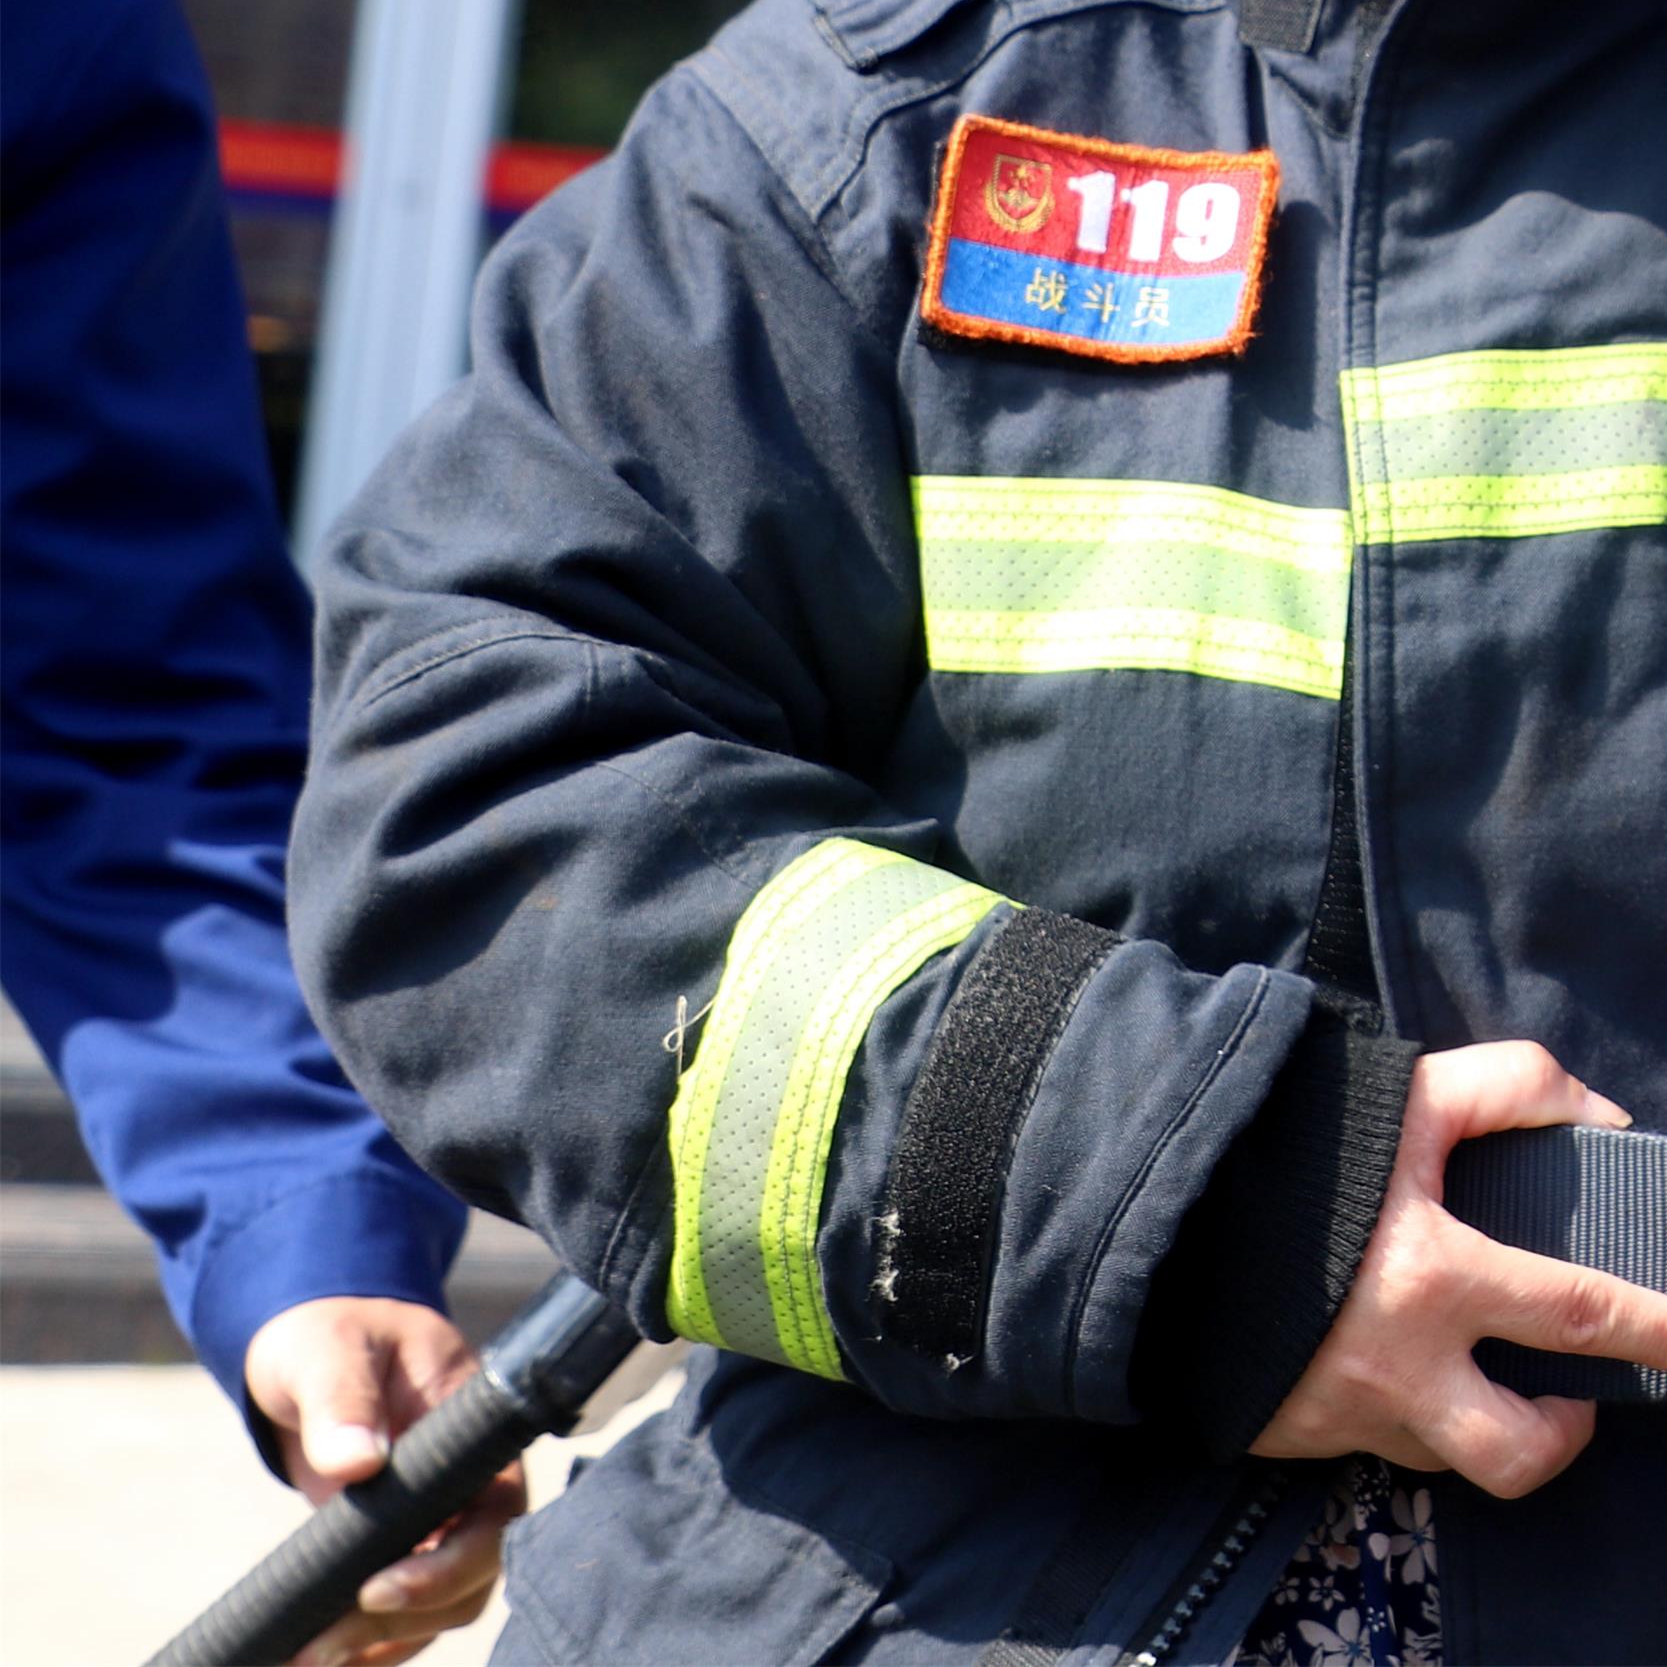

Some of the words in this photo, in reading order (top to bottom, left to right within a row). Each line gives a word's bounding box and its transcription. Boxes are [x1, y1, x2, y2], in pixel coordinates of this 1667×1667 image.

[1067, 170, 1241, 264] 119
[1024, 266, 1173, 328] 战斗员
